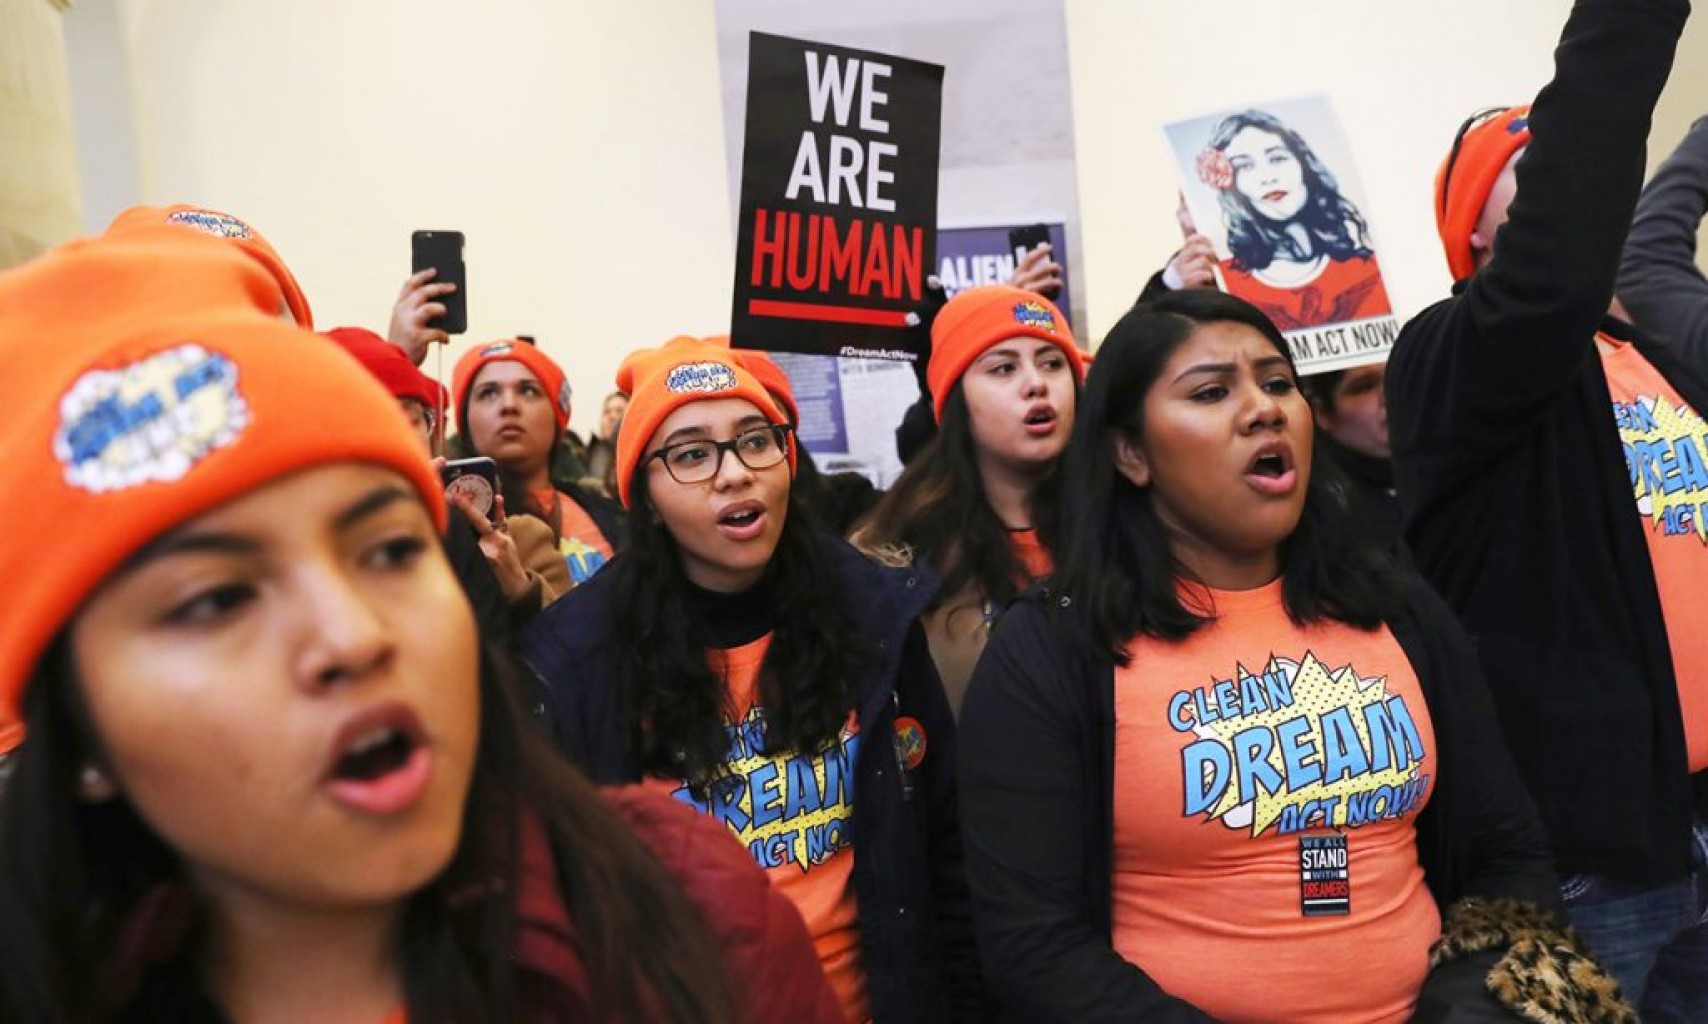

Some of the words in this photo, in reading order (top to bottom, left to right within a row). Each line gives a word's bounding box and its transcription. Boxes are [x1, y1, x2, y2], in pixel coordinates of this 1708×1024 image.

[804, 51, 892, 133] WE
[785, 130, 898, 212] ARE
[752, 208, 923, 300] HUMAN
[1315, 328, 1349, 357] ACT
[1167, 668, 1294, 733] CLEAN
[1181, 694, 1425, 817] DREAM
[1302, 838, 1320, 848] WE
[1324, 838, 1346, 847] ALL
[1302, 848, 1347, 869] STAND
[1304, 881, 1349, 898] DREAMERS
[1312, 870, 1338, 879] WITH
